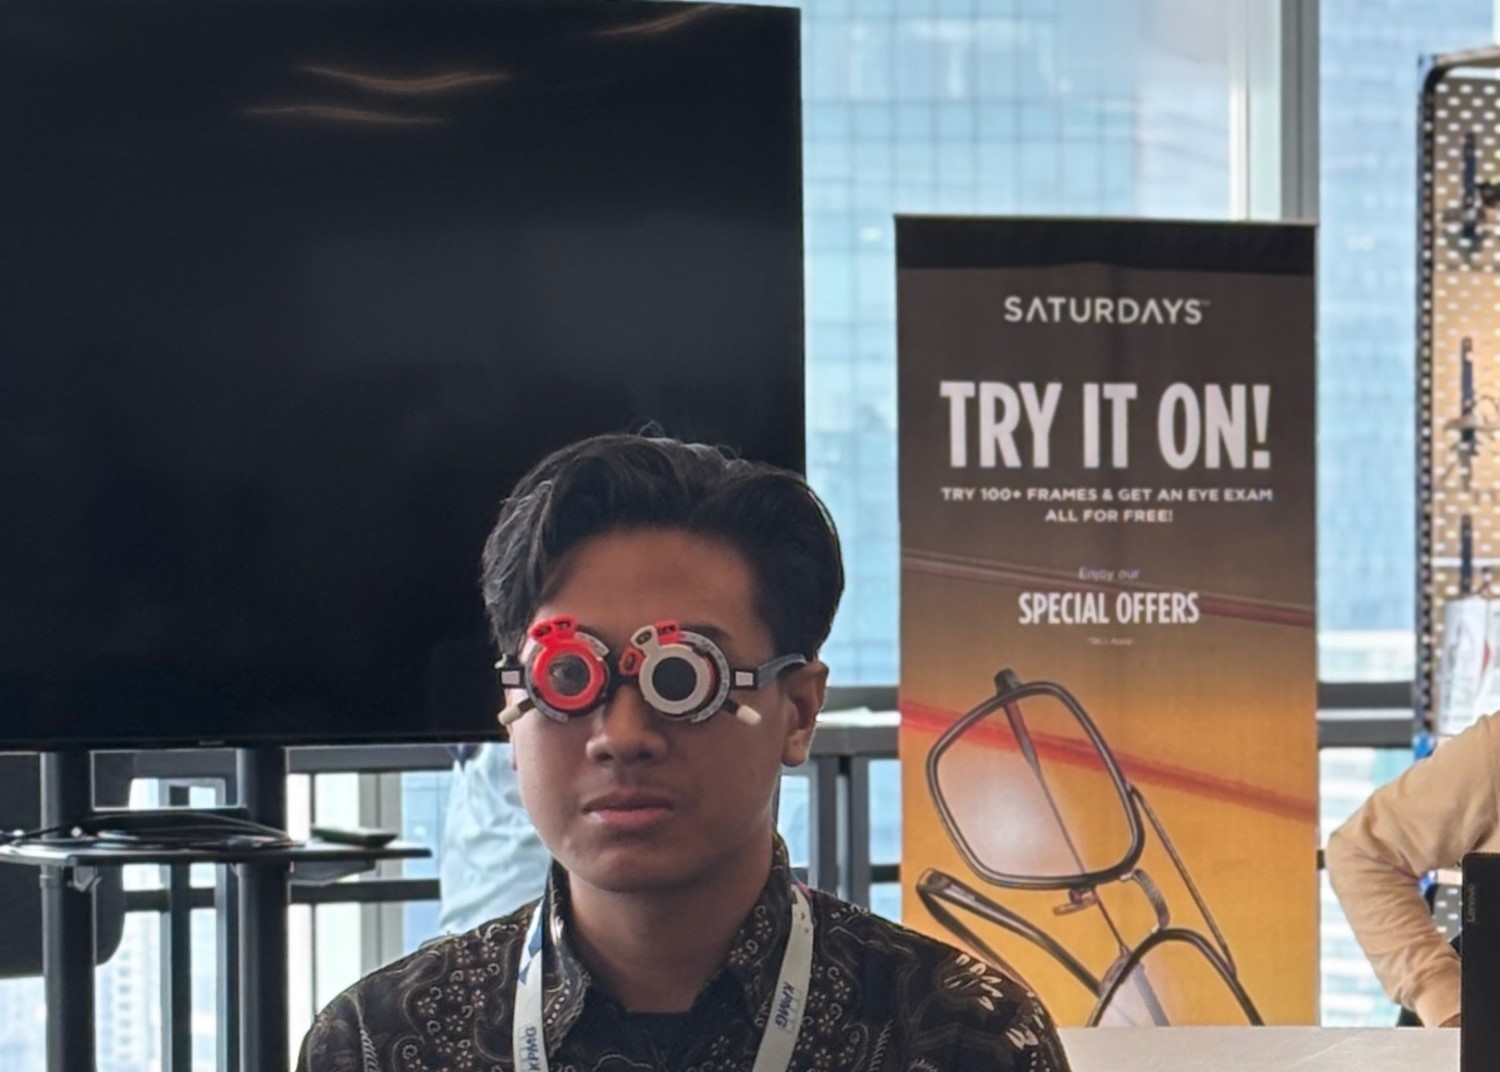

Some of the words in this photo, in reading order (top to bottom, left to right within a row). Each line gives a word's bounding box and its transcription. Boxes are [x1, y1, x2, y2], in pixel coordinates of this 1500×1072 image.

[1003, 296, 1202, 325] SATURDAYS
[939, 380, 1063, 469] TRY
[1083, 382, 1138, 469] IT
[1157, 382, 1272, 470] ON!
[940, 487, 976, 502] TRY
[980, 487, 1022, 502] 100+
[1026, 487, 1098, 502] FRAMES
[1102, 488, 1113, 502] &
[1118, 488, 1153, 502] GET
[1157, 488, 1183, 502] AN
[1187, 488, 1219, 502] EYE
[1223, 488, 1273, 502] EXAM
[1045, 508, 1079, 523] ALL
[1083, 508, 1119, 523] FOR
[1123, 508, 1173, 523] FREE!
[1078, 567, 1114, 582] Enjoy
[1118, 570, 1140, 580] our
[1018, 591, 1110, 625] SPECIAL
[1116, 591, 1200, 625] OFFERS
[775, 981, 796, 1029] KPMG
[525, 1026, 541, 1072] KPMG
